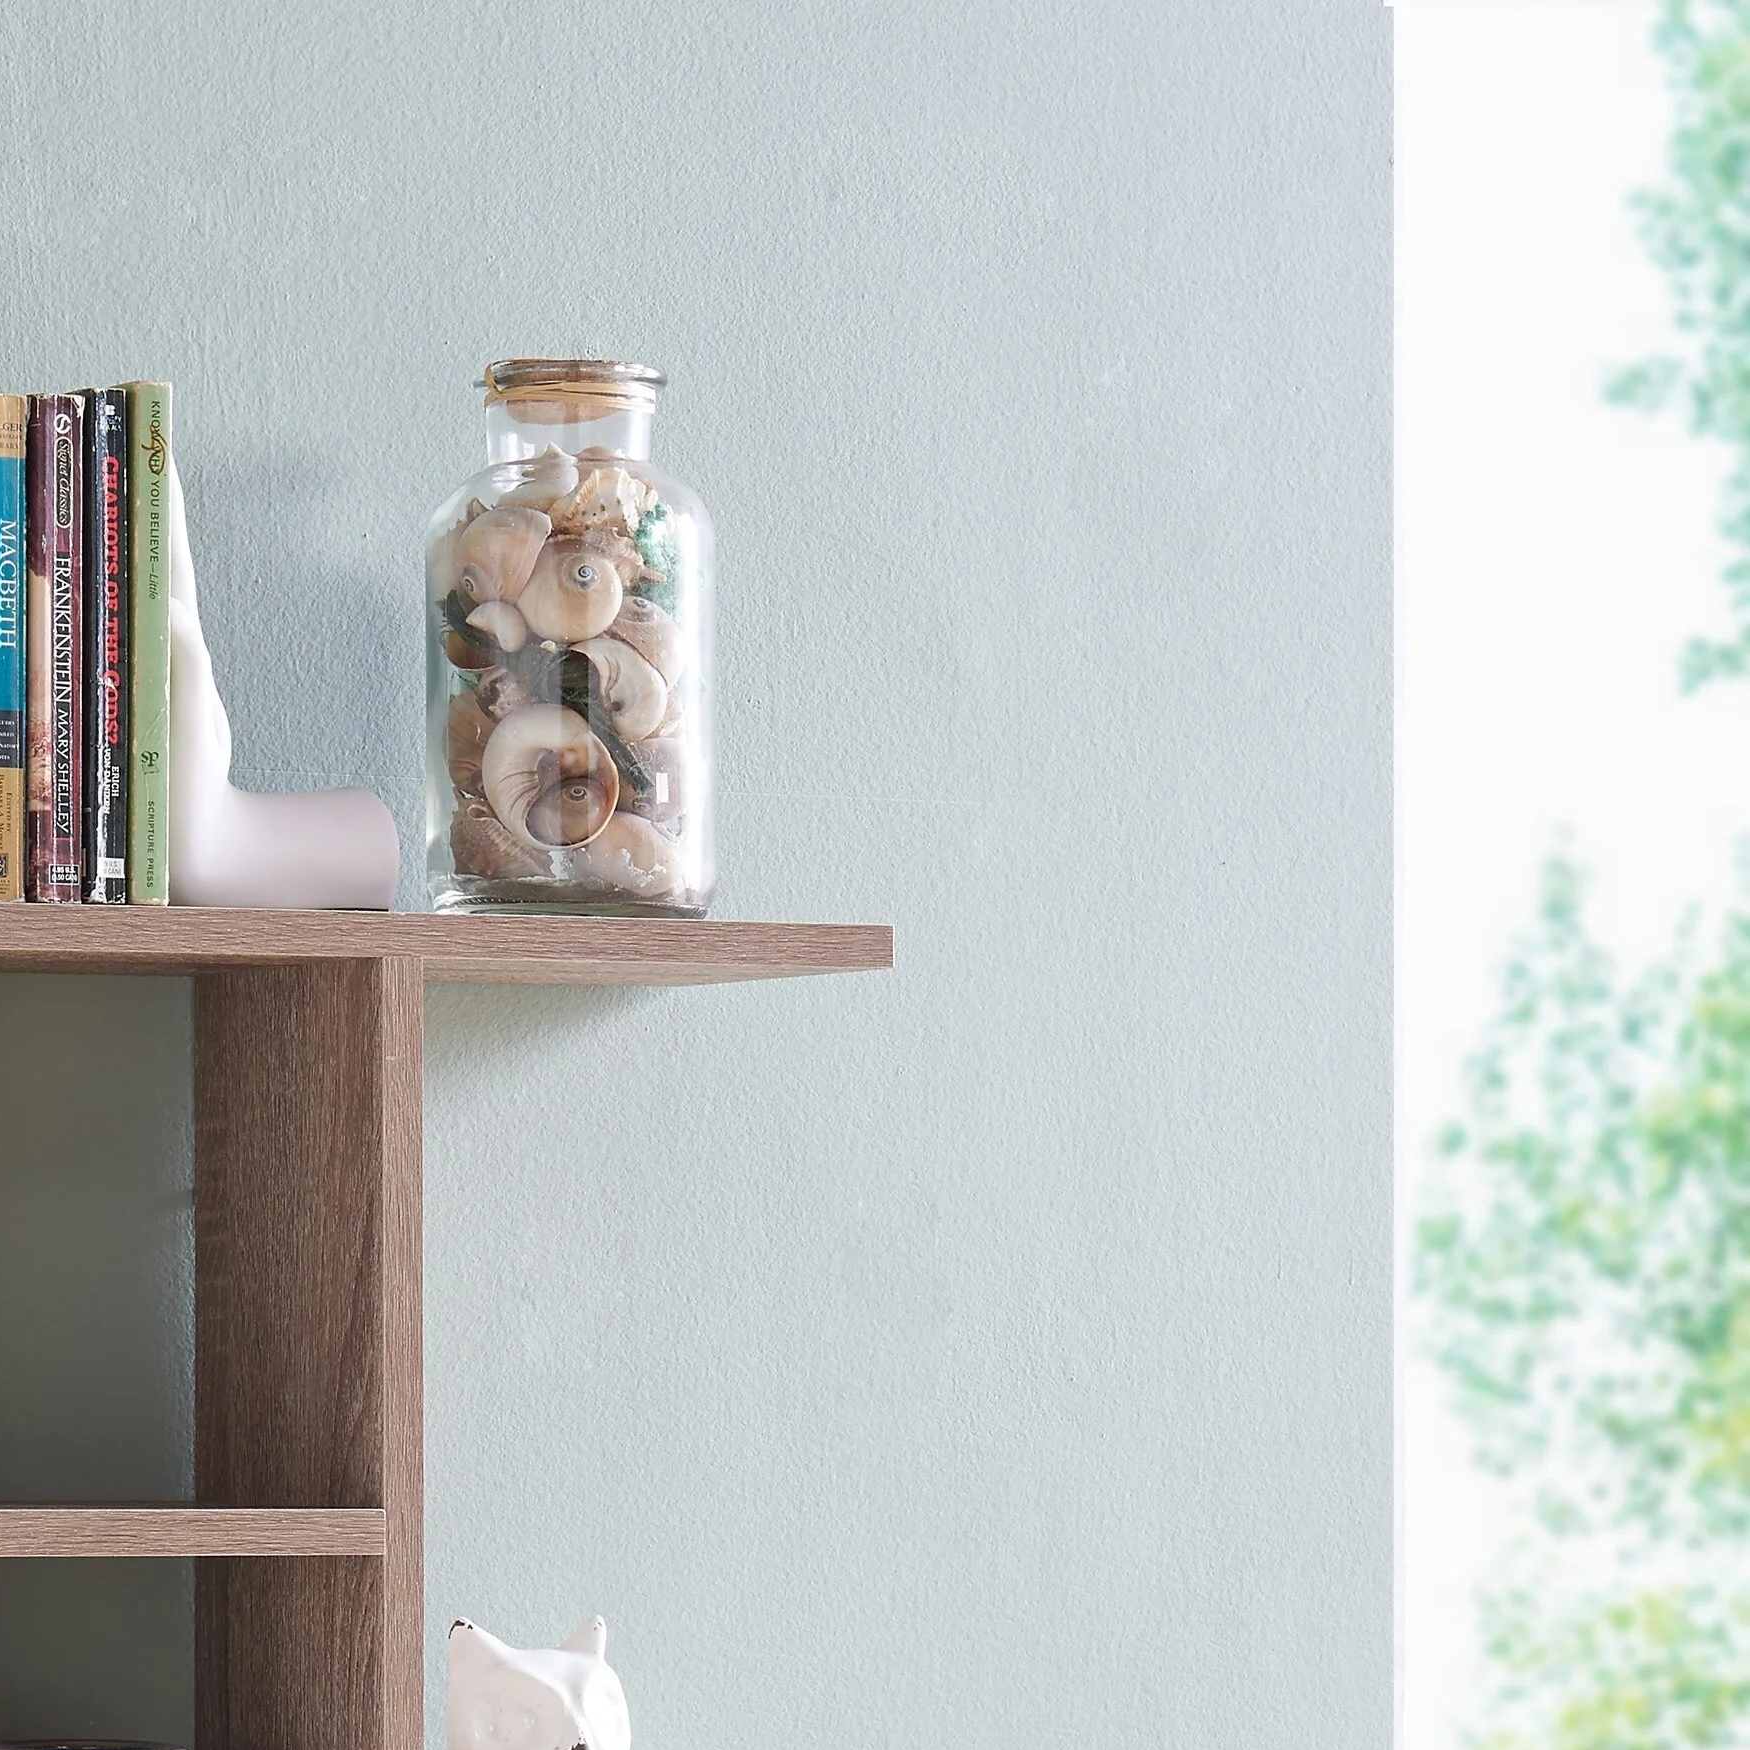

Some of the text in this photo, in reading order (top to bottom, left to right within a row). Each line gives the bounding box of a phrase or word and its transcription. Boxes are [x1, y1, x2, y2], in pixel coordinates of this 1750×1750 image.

[150, 446, 161, 476] WHY
[151, 401, 161, 442] KNOW
[56, 441, 70, 523] Signet Classics
[150, 480, 160, 507] YOU
[0, 518, 17, 649] MACBETH
[102, 455, 121, 745] CHARIOTS OF THE GODS?
[53, 556, 72, 834] FRANKENSTEIN MARY SHELLEY
[110, 765, 121, 796] ERICH
[146, 800, 155, 888] SCRIPTURE PRESS
